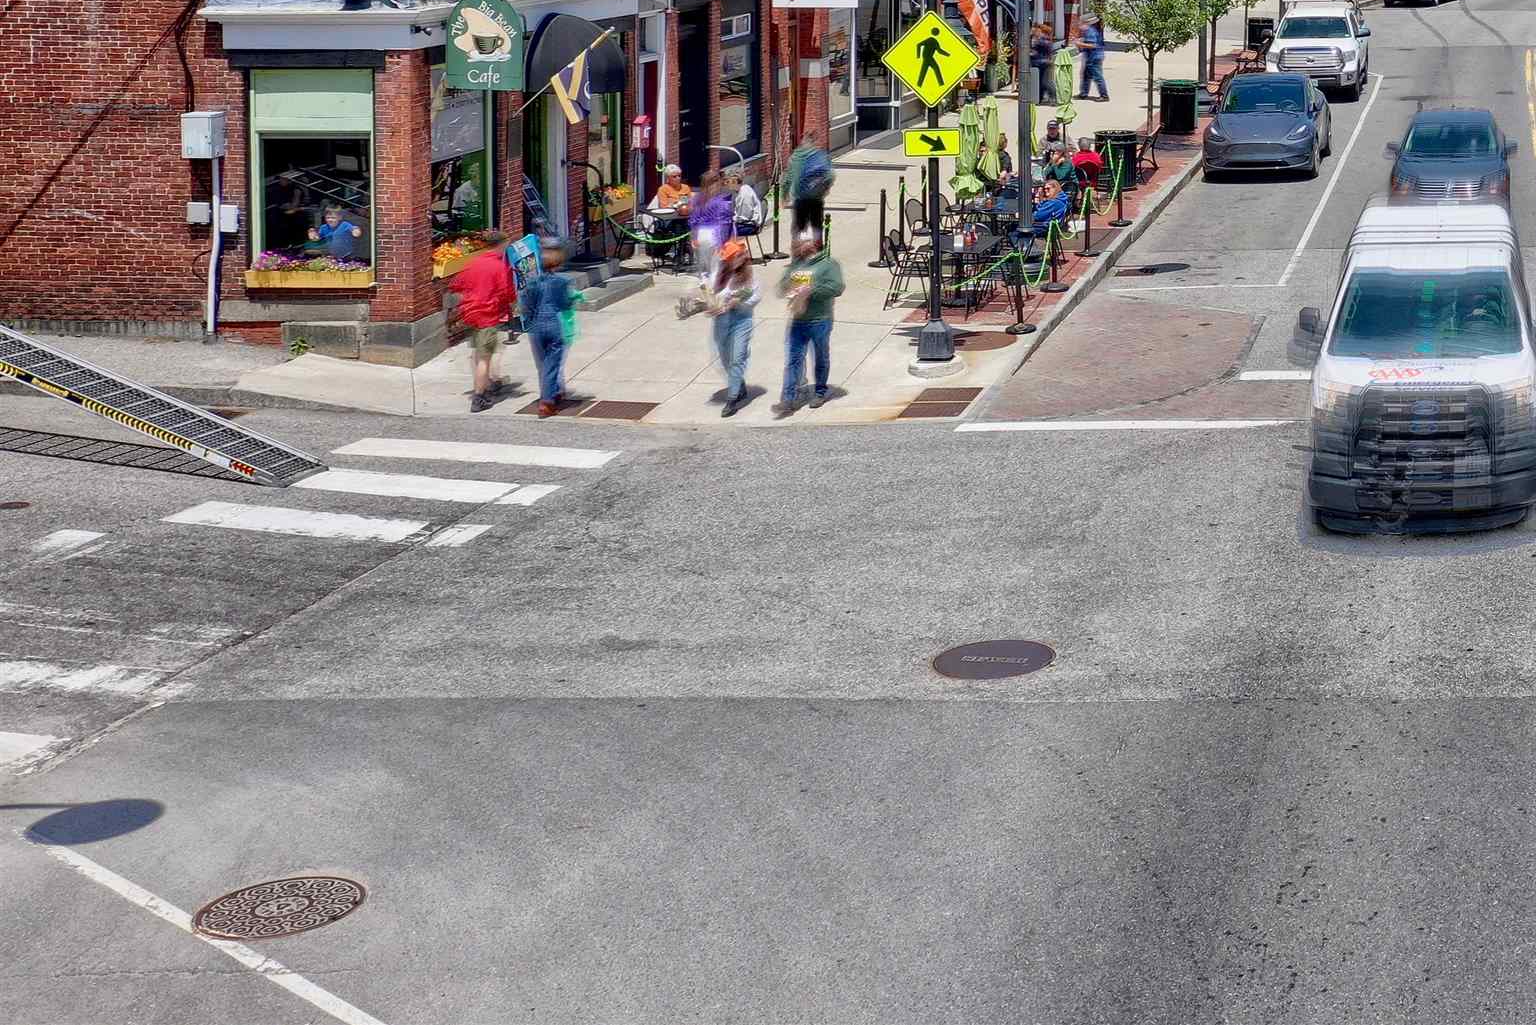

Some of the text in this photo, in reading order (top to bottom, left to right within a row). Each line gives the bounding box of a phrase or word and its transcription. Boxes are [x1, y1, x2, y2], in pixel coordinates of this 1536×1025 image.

[451, 0, 518, 38] The Big Bean
[467, 64, 501, 88] Cafe
